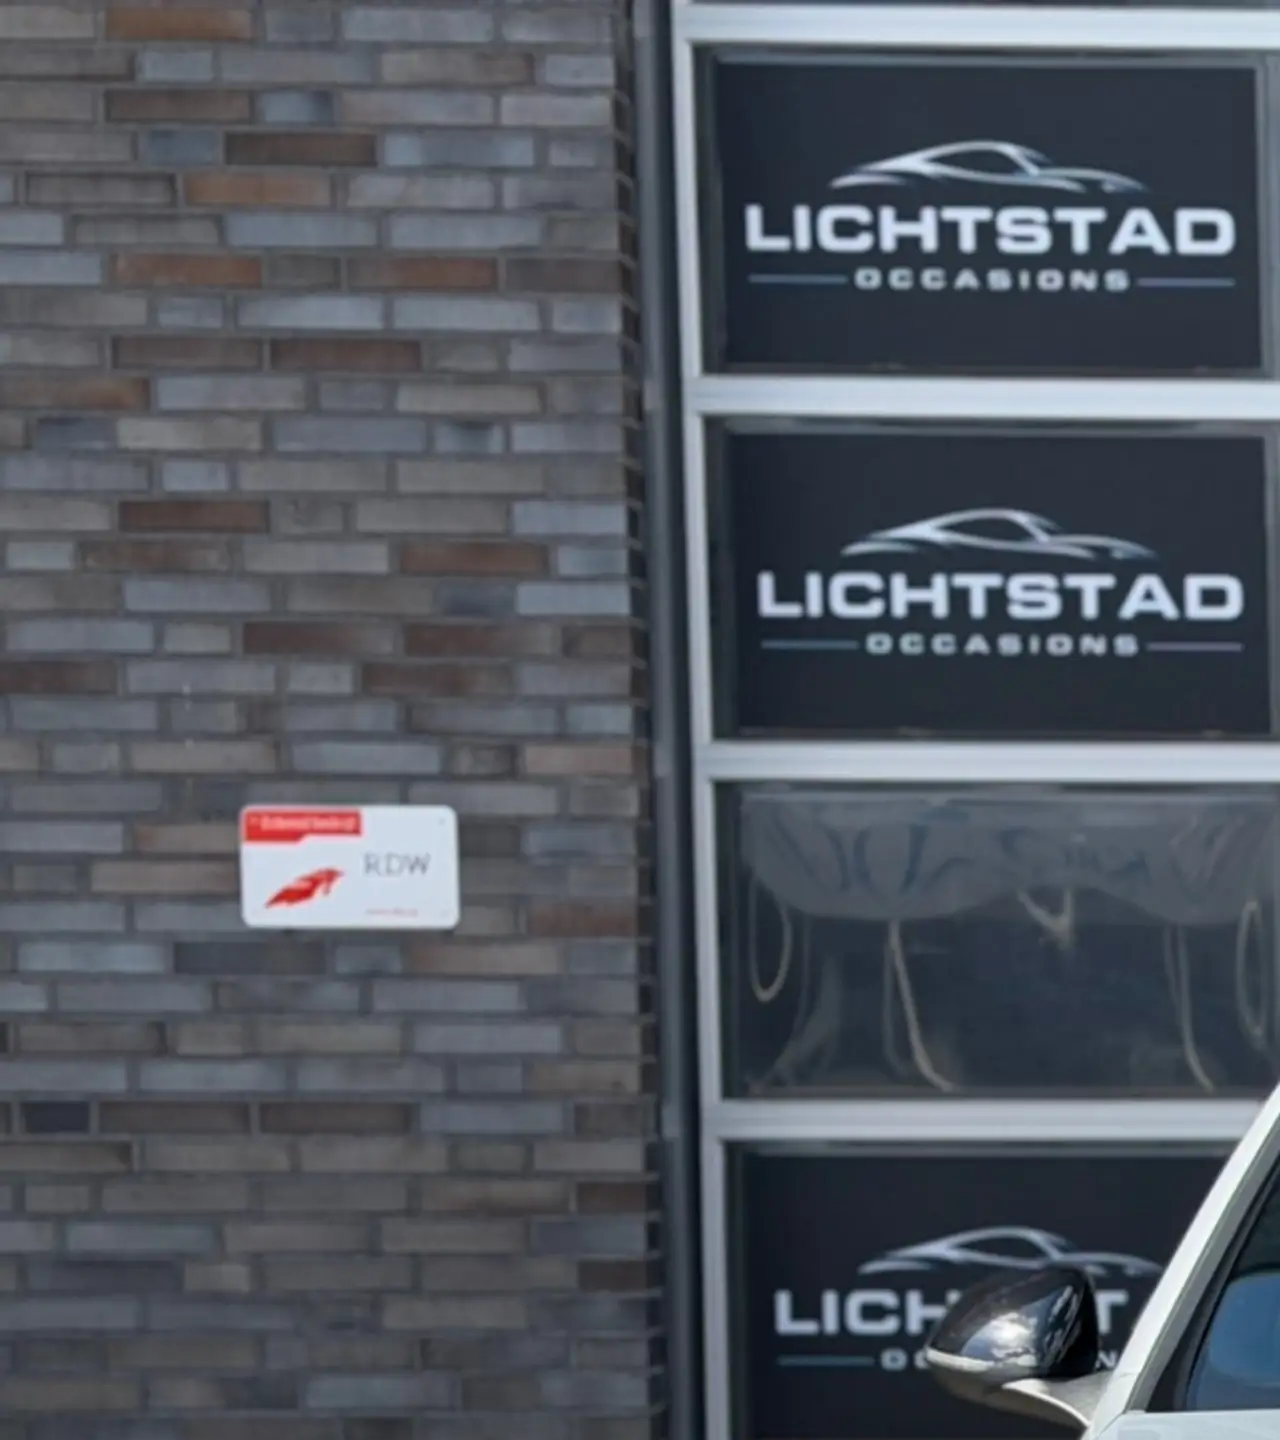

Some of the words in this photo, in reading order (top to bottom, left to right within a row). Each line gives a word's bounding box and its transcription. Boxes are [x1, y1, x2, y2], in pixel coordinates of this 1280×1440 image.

[745, 204, 1236, 257] LICHTSTAD
[854, 267, 1130, 292] OCCASIONS
[758, 572, 1244, 621] LICHTSTAD
[866, 633, 1139, 657] OCCASIONS
[363, 852, 432, 877] RDW
